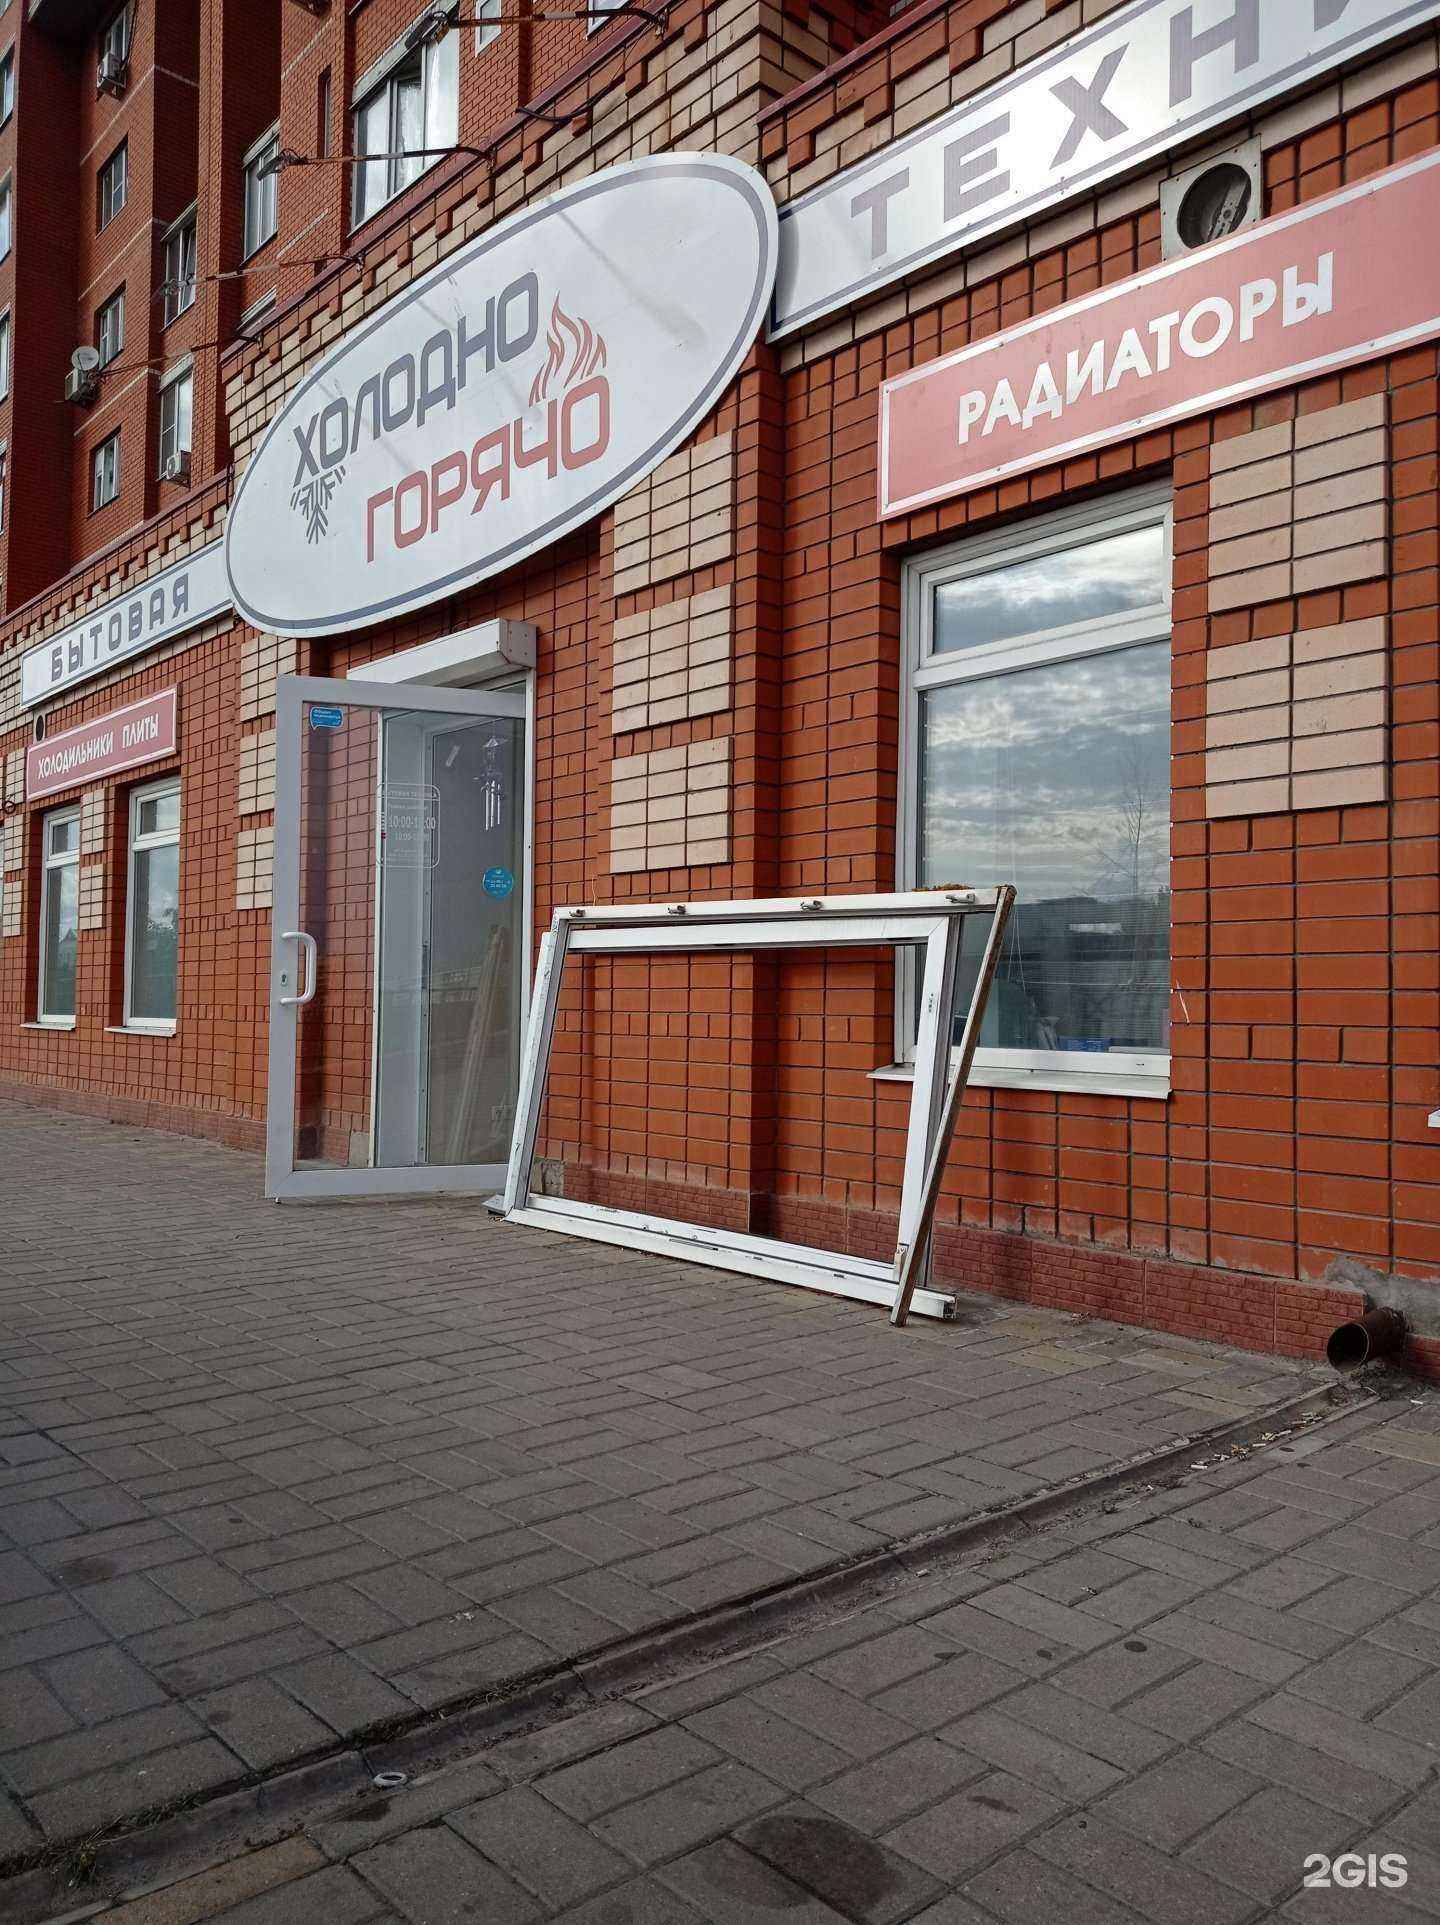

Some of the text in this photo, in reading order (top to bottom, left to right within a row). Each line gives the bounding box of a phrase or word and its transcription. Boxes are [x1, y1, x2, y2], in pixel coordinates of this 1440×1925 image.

[292, 271, 539, 487] ХОЛОДНО
[957, 250, 1334, 445] РАДИАТОРЫ
[366, 376, 611, 563] ГОРЯЧО
[50, 573, 189, 682] БЫТОВАЯ
[37, 714, 159, 779] ХОЛОДИЛЬНИКИ ПЛИТЫ
